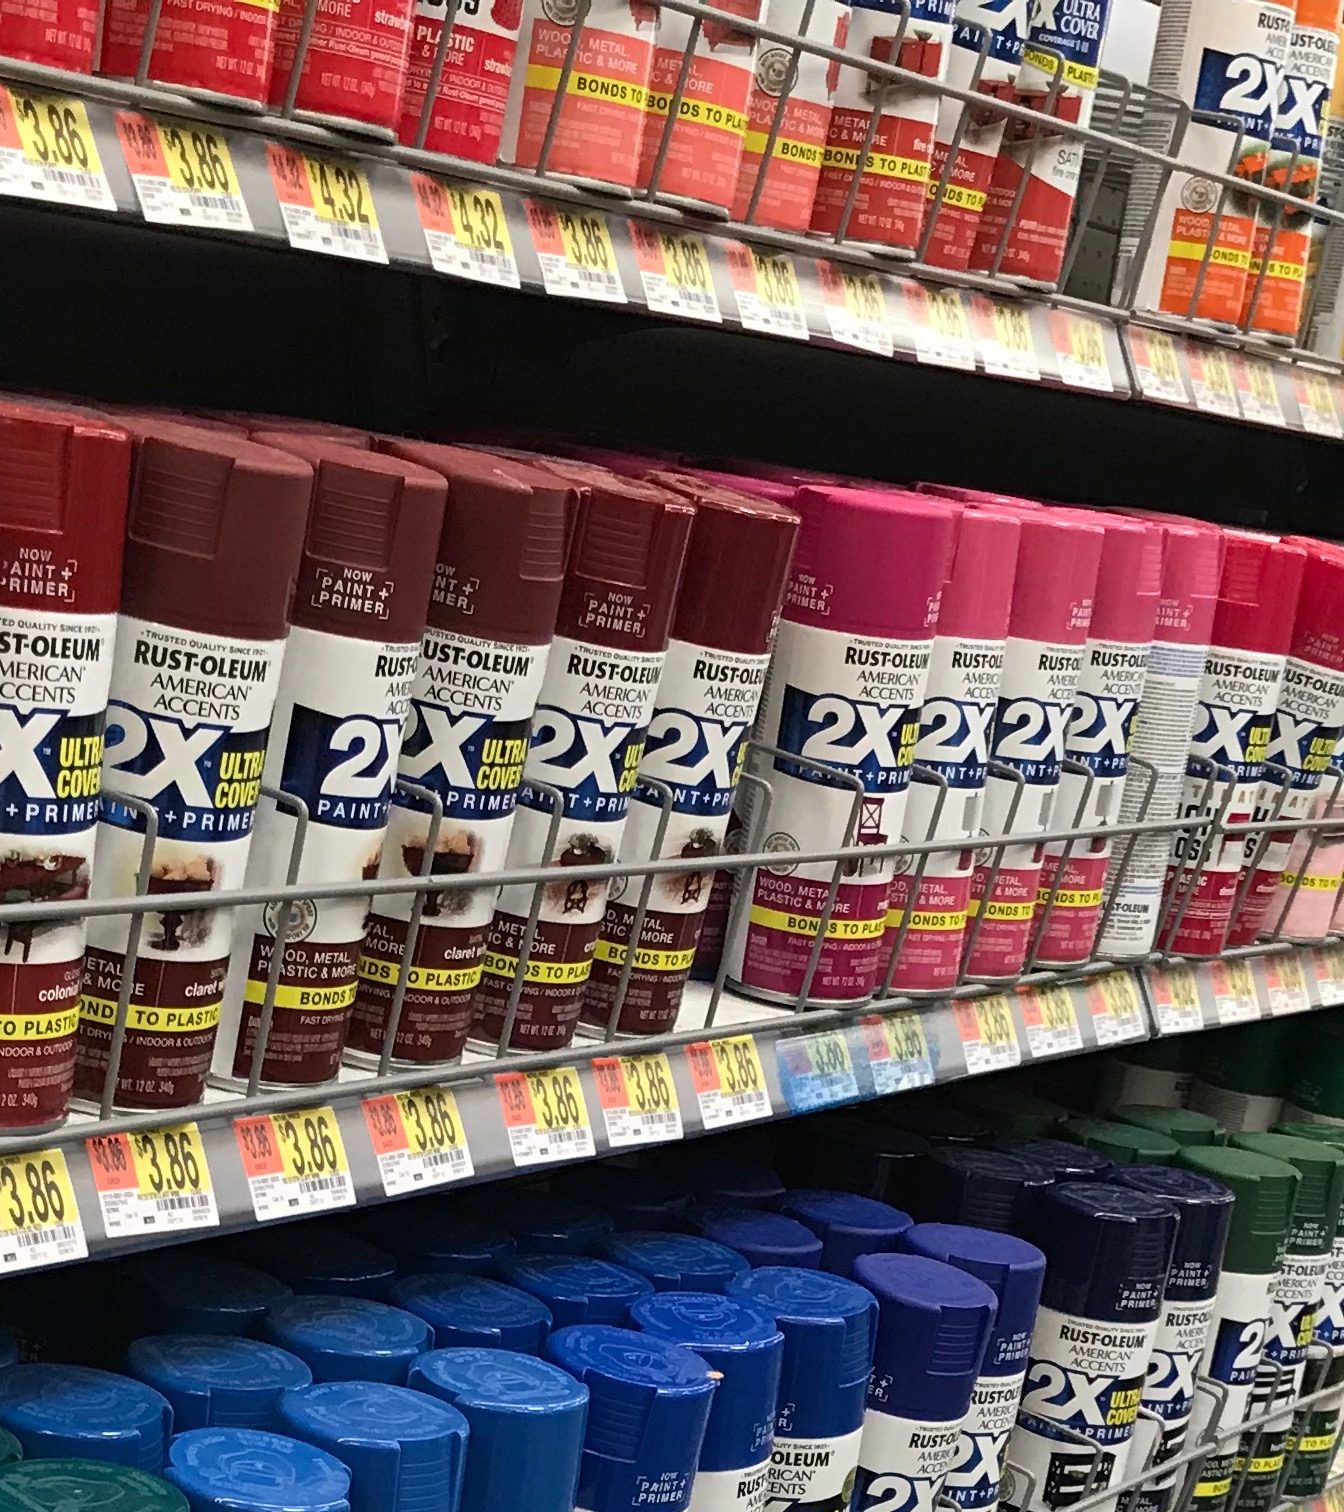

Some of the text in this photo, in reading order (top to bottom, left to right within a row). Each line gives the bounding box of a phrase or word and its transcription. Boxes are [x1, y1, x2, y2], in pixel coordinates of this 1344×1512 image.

[1061, 15, 1099, 40] COVER
[576, 76, 627, 102] BONDS
[13, 91, 91, 169] $3.86
[20, 548, 52, 561] NOW
[343, 568, 373, 582] NOW
[321, 577, 373, 598] PAINT
[607, 591, 634, 605] NOW
[318, 590, 386, 618] PRIMER
[587, 601, 632, 621] PAINT
[585, 615, 642, 635] PRIMER
[133, 644, 269, 683] RUST-OLEUM
[150, 674, 249, 701] AMERICAN
[422, 665, 512, 694] AMERICAN
[856, 670, 920, 686] AMERICAN
[424, 686, 503, 711] ACCENTS
[859, 685, 915, 700] ACCENTS
[153, 694, 241, 721] ACCENTS
[580, 702, 643, 720] ACCENTS
[802, 695, 904, 768] 2X
[219, 752, 264, 782] ULTRA
[215, 780, 261, 809] COVER
[759, 877, 794, 895] WOOD,
[185, 981, 218, 998] claret
[425, 969, 477, 989] PLASTIC
[299, 989, 345, 1007] BONDS
[23, 1012, 77, 1036] PLASTIC
[134, 1006, 219, 1027] TO PLASTIC
[626, 1058, 672, 1110] $3.86
[532, 1075, 581, 1131] $3.86
[279, 1115, 339, 1177] $3.86
[134, 1131, 202, 1193] $3.86
[1059, 1326, 1146, 1349] RUST-OLEUM
[1071, 1358, 1127, 1373] ACCENTS
[1026, 1365, 1116, 1423] 2X
